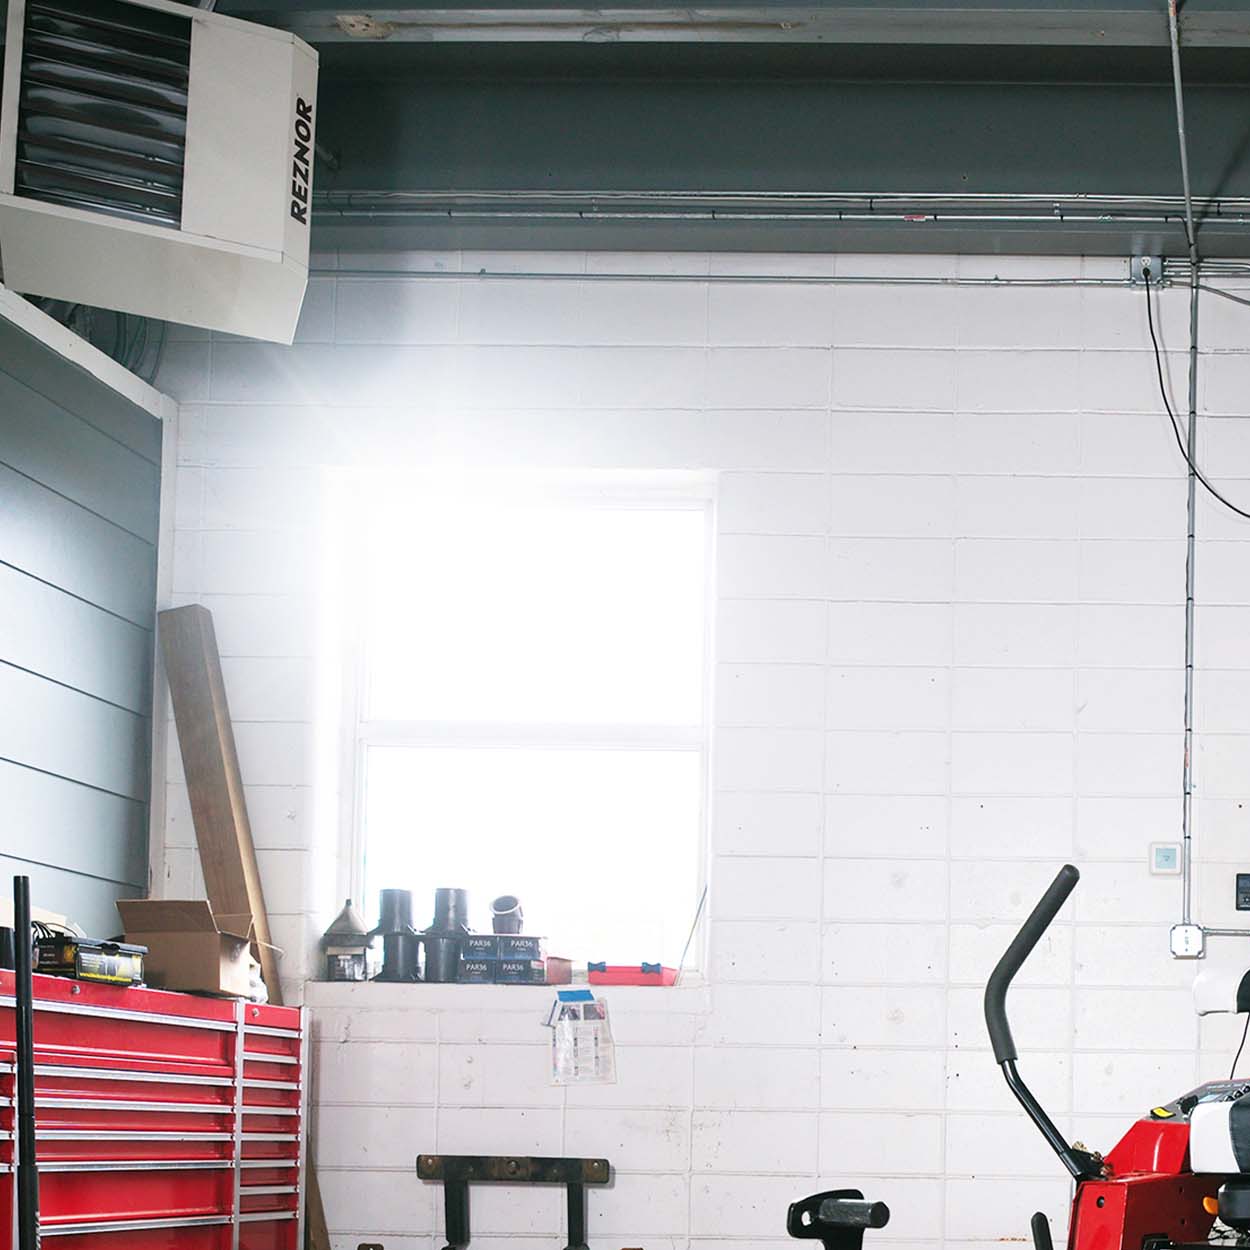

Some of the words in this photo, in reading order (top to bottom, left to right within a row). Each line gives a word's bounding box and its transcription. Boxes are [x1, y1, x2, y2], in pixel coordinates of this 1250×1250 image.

[290, 97, 313, 226] REZNOR
[466, 963, 487, 971] PAR36
[503, 963, 524, 971] PAR36
